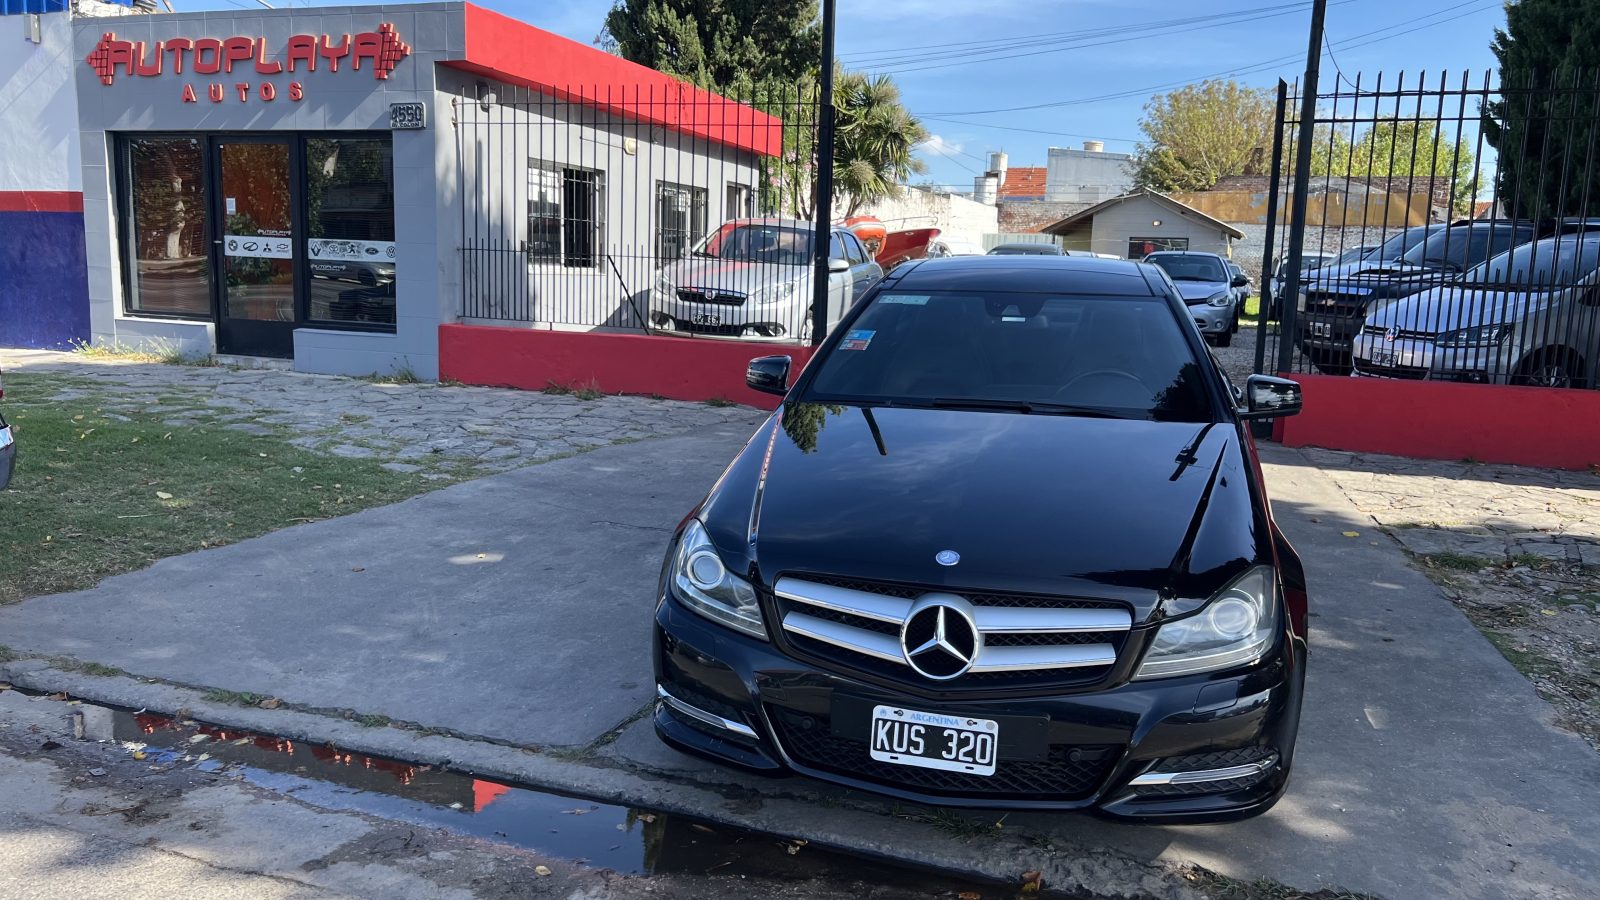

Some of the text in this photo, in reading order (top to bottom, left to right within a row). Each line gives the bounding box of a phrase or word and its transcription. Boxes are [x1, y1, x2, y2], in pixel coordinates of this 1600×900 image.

[110, 32, 385, 77] AUTOPLAYA
[182, 82, 303, 102] AUTOS
[391, 105, 422, 122] 4550
[910, 713, 960, 726] ARGENTINA
[876, 720, 992, 764] KUS 320
